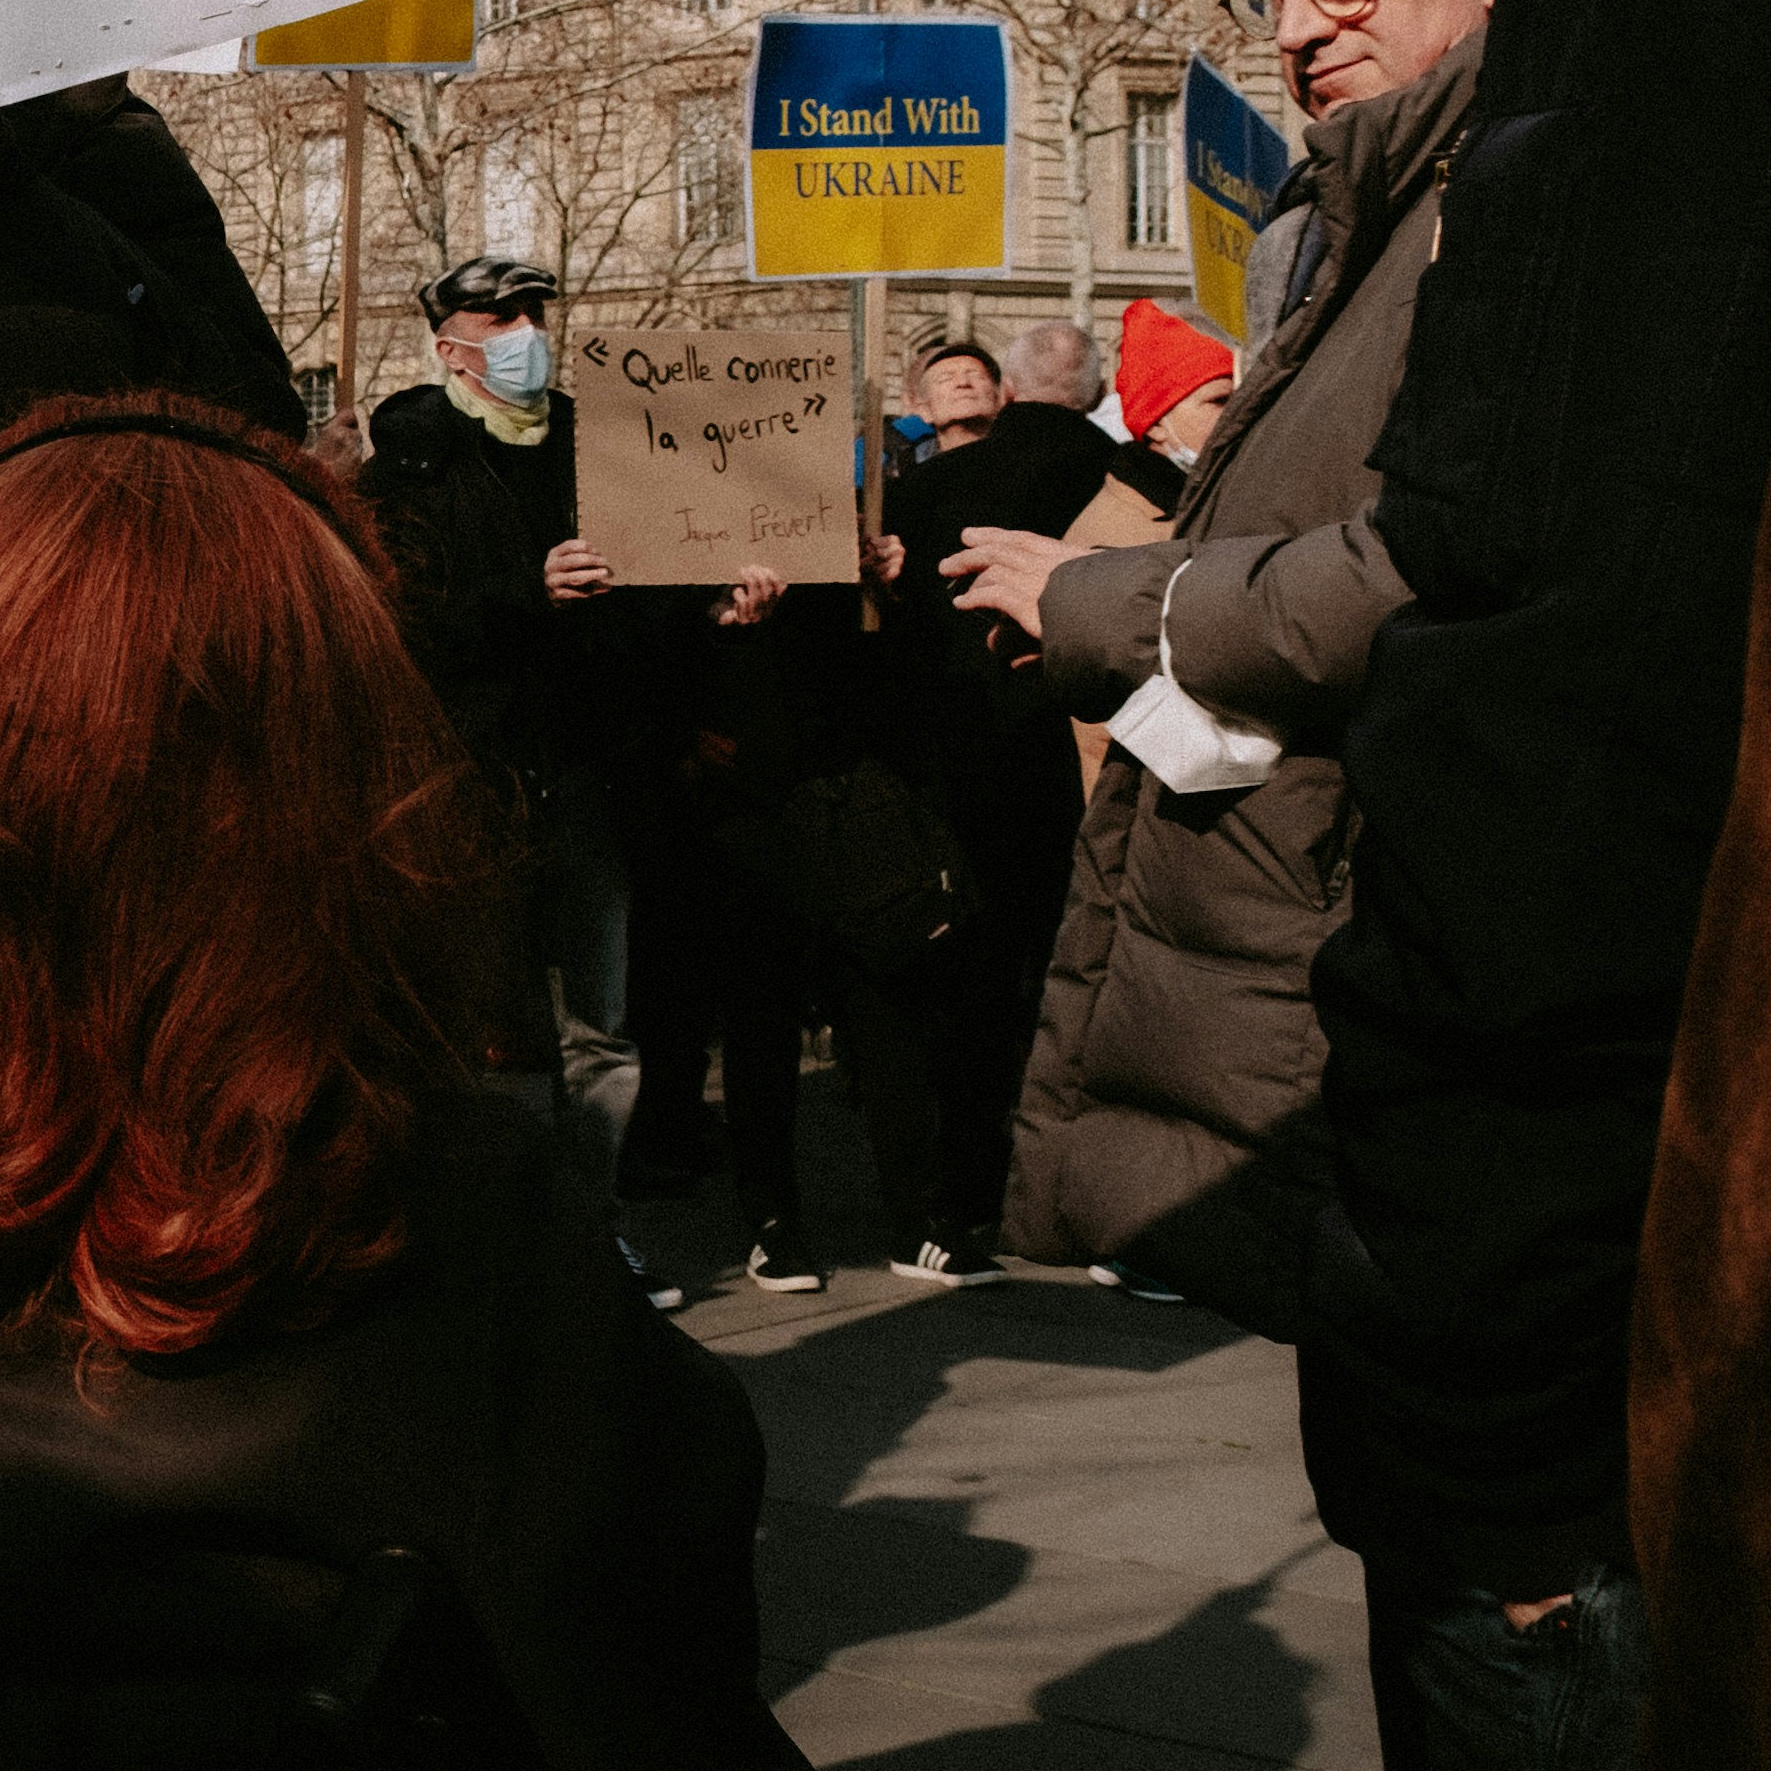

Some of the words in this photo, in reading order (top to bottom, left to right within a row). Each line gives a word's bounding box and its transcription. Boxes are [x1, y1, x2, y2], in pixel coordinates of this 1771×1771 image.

[778, 98, 791, 137] I
[799, 96, 895, 137] Stand
[903, 95, 981, 135] With
[794, 159, 966, 199] UKRAINE
[622, 343, 714, 395] Quelle
[727, 348, 838, 384] connerie
[644, 408, 679, 455] la
[749, 493, 833, 544] Prévert
